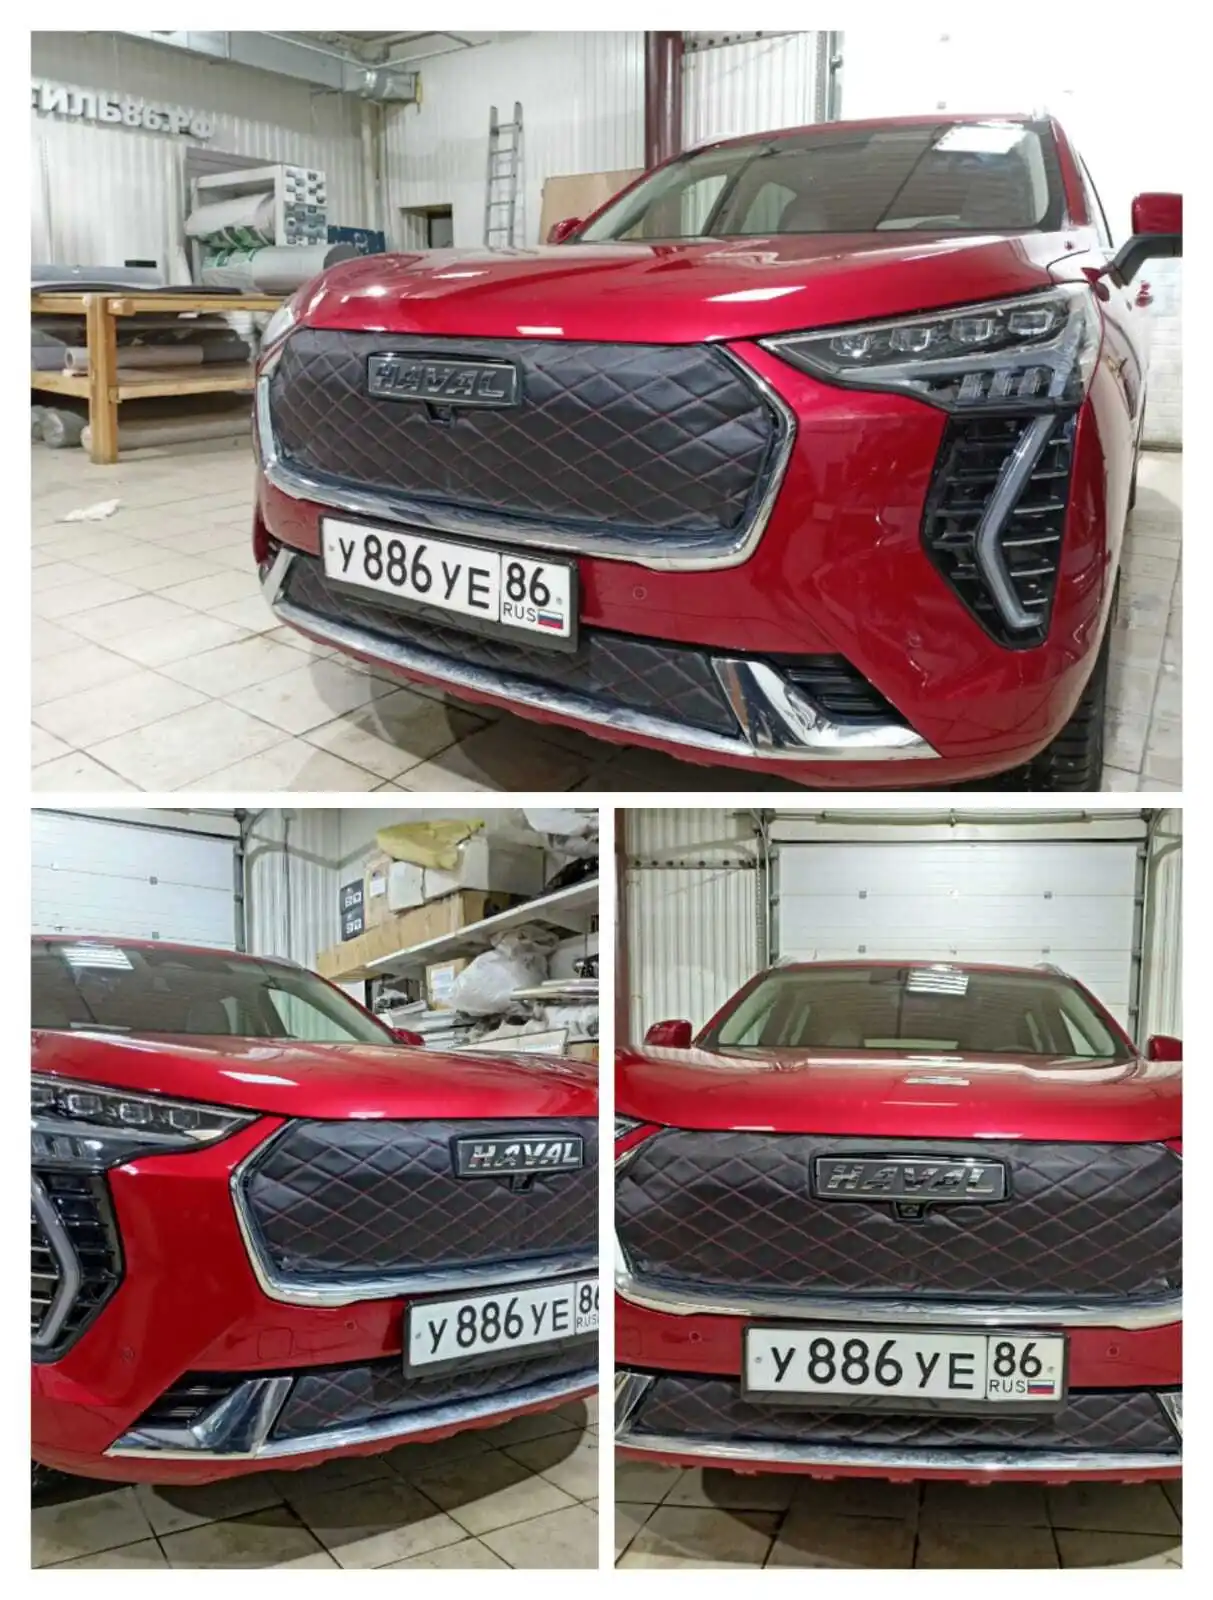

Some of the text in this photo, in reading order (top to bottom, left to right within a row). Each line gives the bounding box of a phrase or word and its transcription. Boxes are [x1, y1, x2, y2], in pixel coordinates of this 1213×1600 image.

[372, 364, 505, 397] HAVAL
[363, 534, 432, 593] 886
[505, 562, 550, 607] 86
[502, 602, 536, 622] RUS
[468, 1142, 580, 1168] HAVAL
[826, 1163, 994, 1193] HAVAL
[456, 1297, 524, 1348] 886
[807, 1337, 903, 1387] 886
[993, 1341, 1043, 1379] 86
[988, 1379, 1026, 1394] RUS
